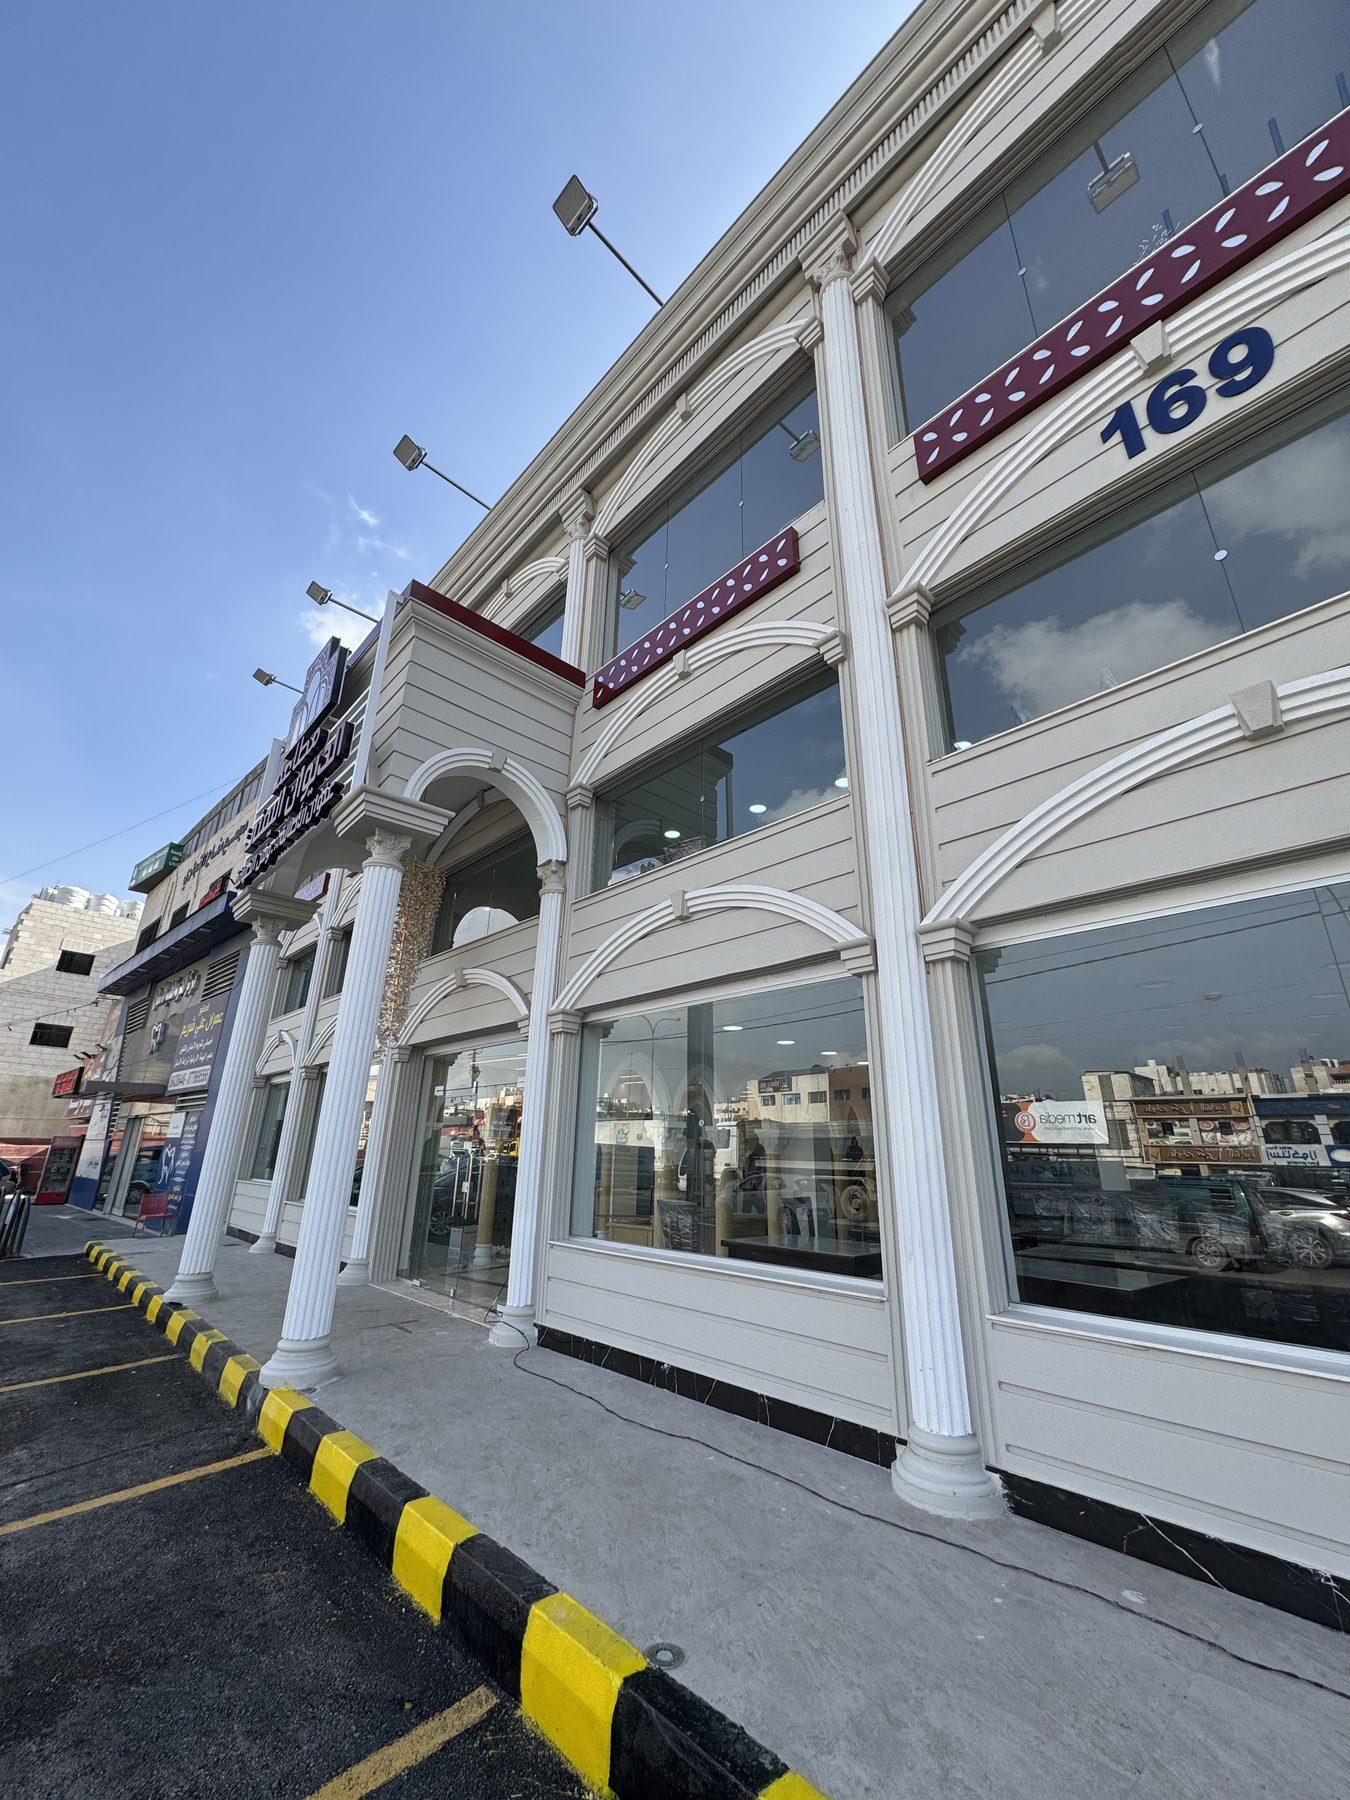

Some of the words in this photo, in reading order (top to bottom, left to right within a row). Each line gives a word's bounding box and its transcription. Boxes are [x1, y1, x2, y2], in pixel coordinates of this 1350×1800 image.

[1099, 326, 1275, 460] 169
[273, 728, 321, 791] مطاعم
[283, 720, 346, 817] الديوان
